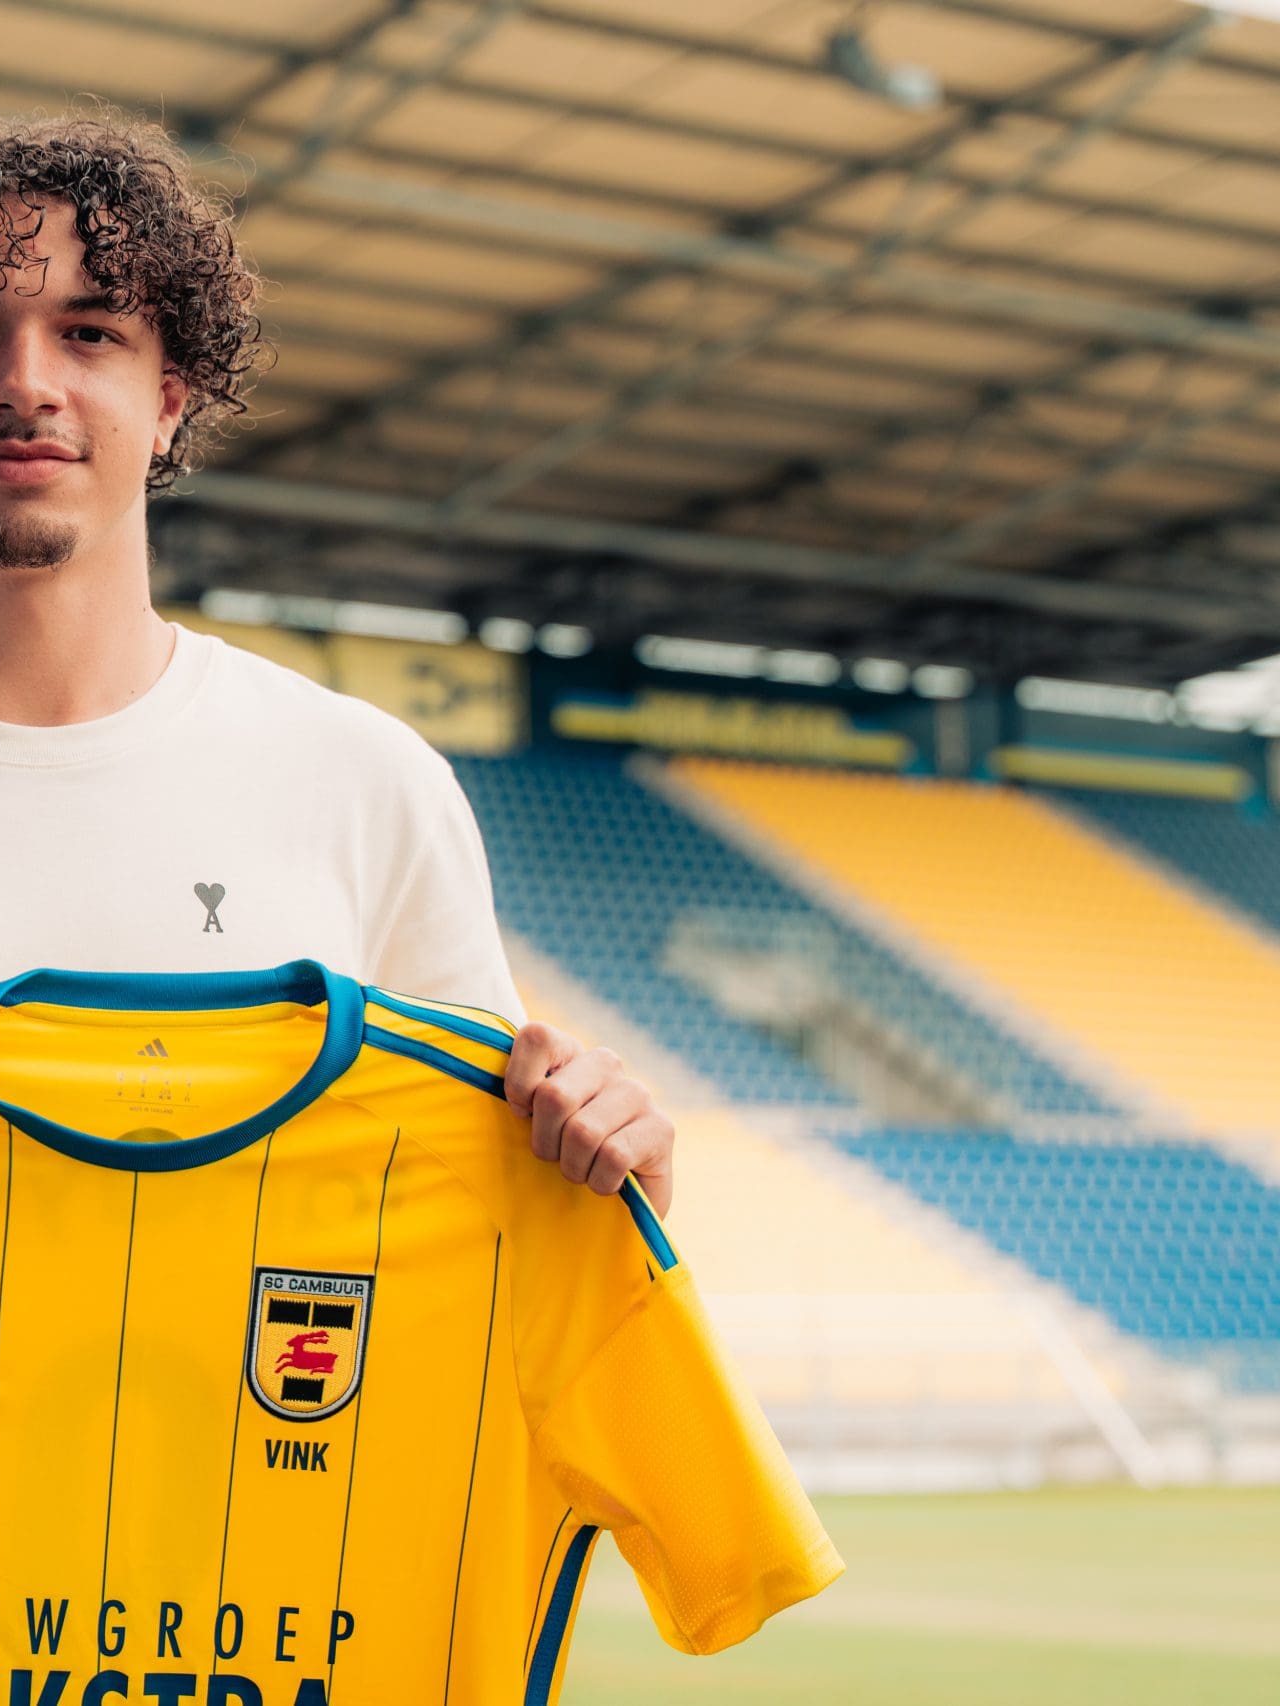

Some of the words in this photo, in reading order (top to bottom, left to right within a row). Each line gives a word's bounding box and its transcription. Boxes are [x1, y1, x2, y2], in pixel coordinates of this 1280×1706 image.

[263, 1276, 284, 1289] SC
[288, 1278, 365, 1295] CAMBUUR
[265, 1438, 330, 1472] VINK
